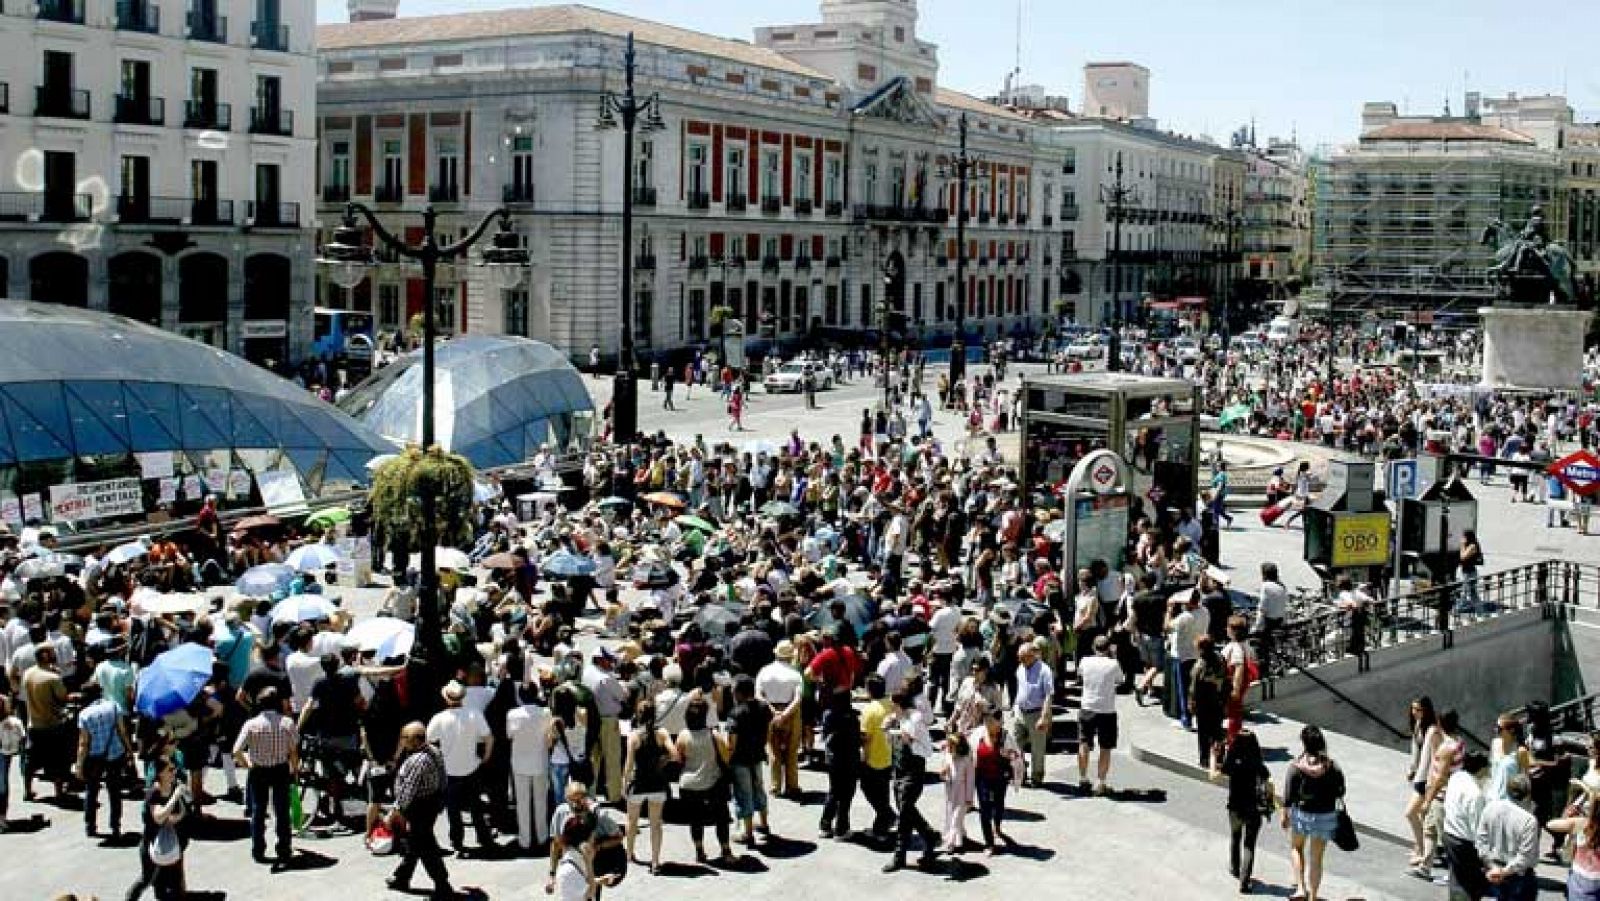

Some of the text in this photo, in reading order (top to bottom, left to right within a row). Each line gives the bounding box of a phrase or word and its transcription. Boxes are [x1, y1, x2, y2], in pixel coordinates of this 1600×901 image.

[1397, 464, 1412, 496] P
[1565, 466, 1597, 479] Metro
[1343, 533, 1378, 551] ORO
